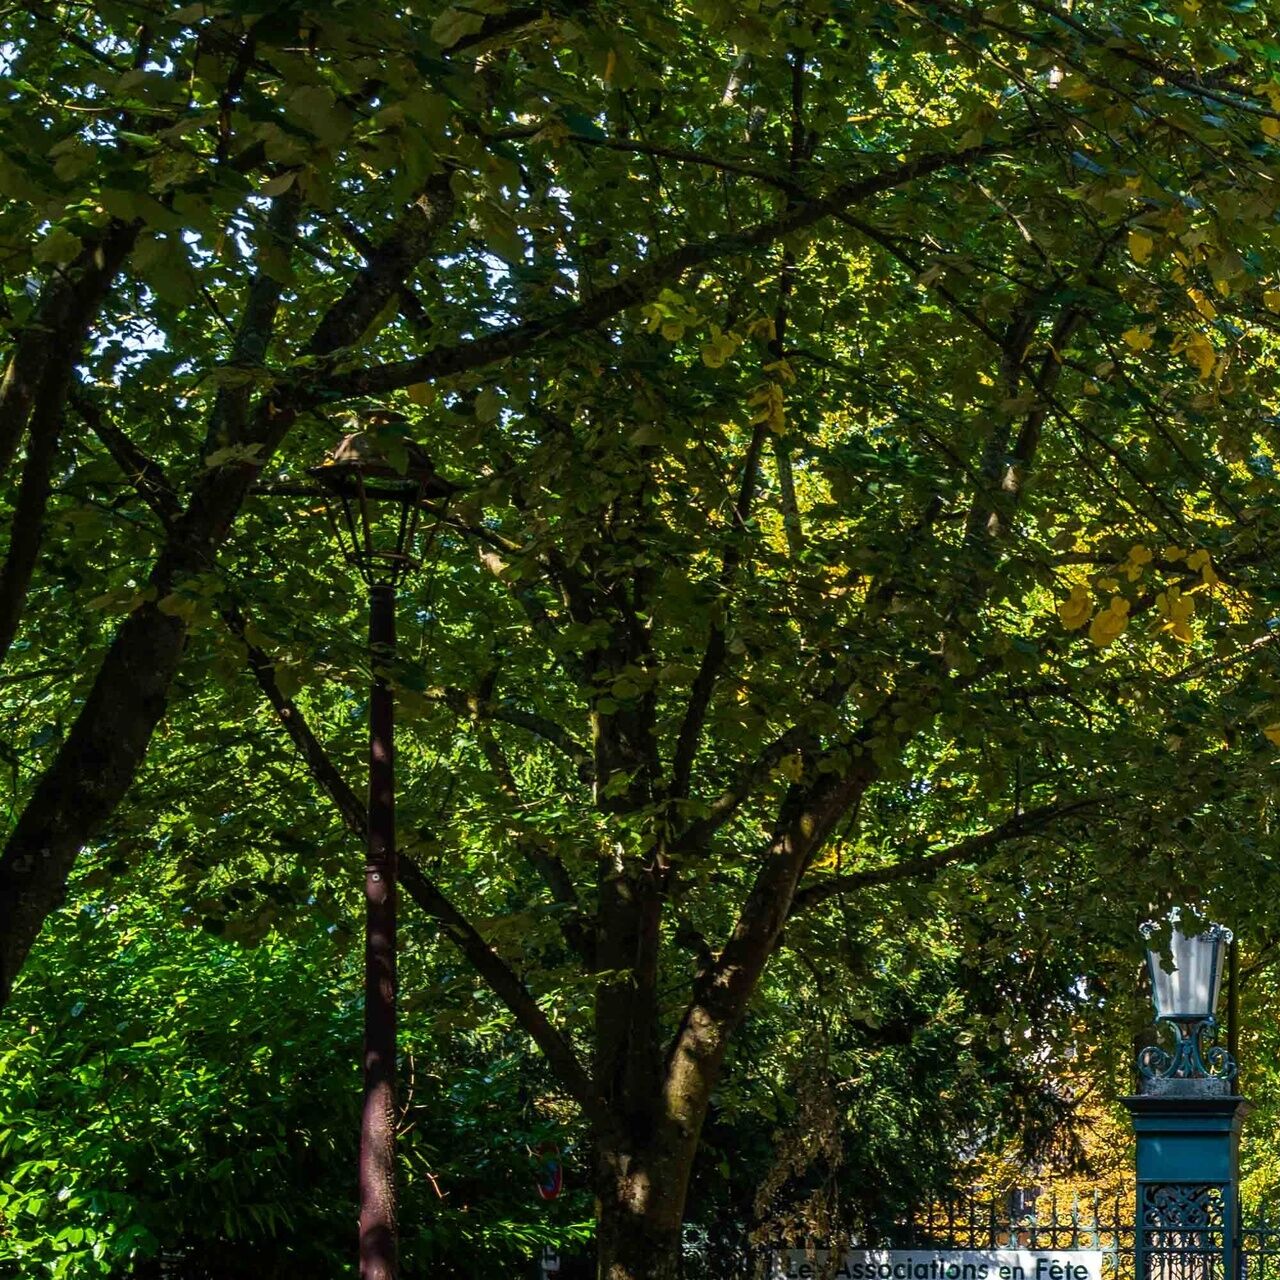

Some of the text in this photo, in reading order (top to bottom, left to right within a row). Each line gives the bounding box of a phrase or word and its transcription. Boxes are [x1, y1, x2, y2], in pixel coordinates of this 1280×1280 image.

[835, 1258, 988, 1280] Associations
[1000, 1265, 1025, 1280] en
[1036, 1258, 1088, 1280] Fête
